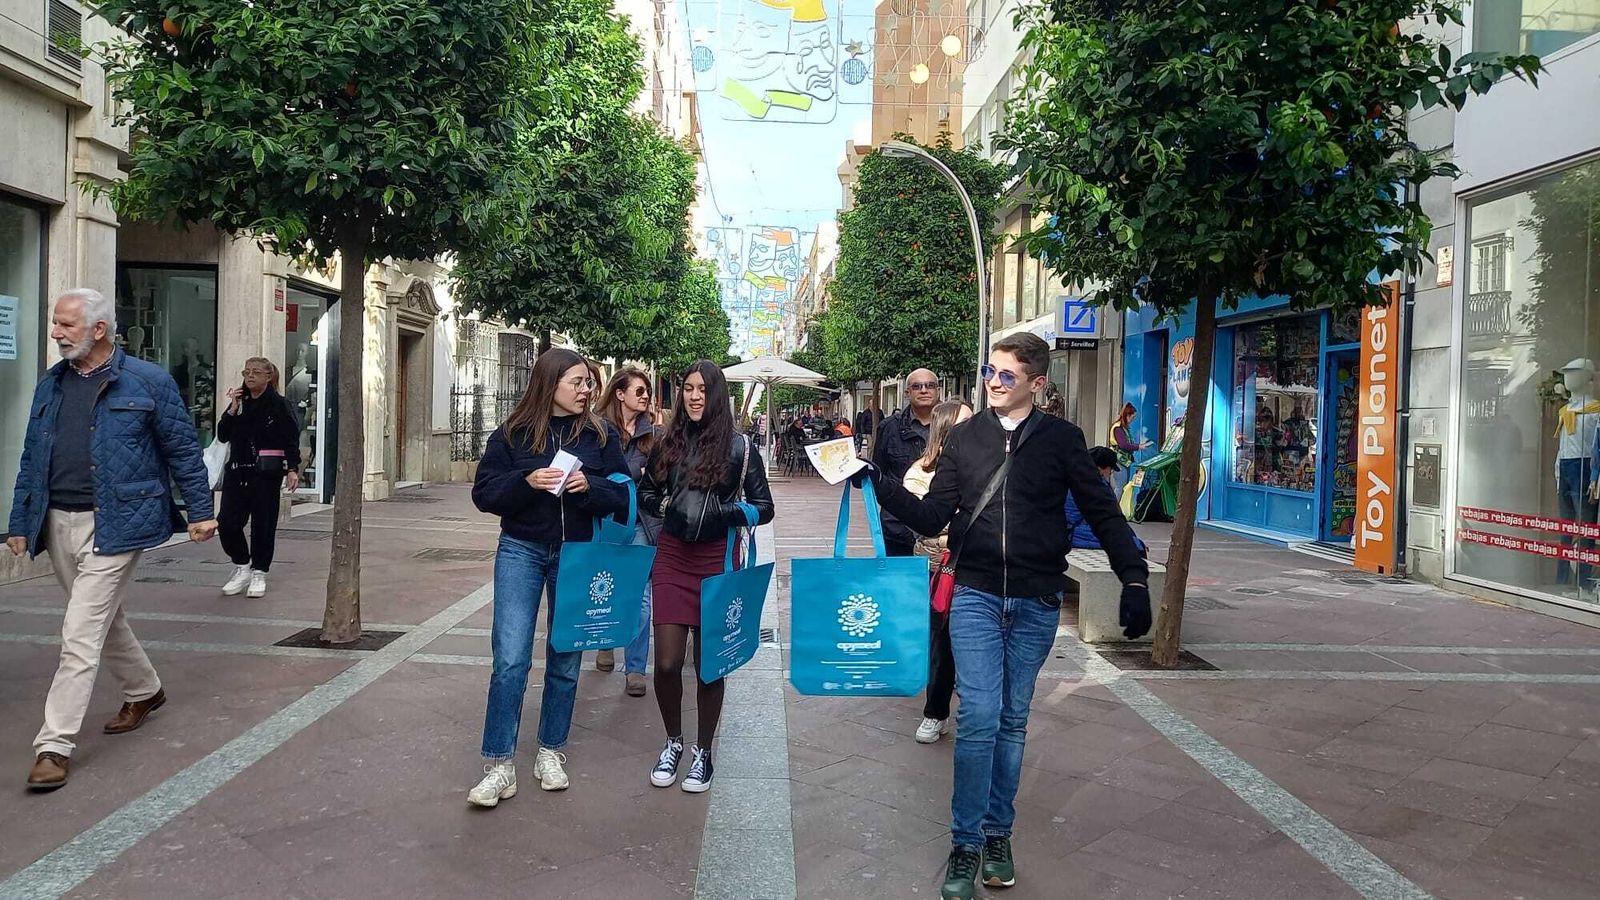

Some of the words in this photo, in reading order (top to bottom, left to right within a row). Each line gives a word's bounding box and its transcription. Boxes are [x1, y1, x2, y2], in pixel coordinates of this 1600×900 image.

[1362, 305, 1388, 455] Planet
[1361, 470, 1391, 548] Toy
[1459, 508, 1489, 520] rebajas
[1491, 512, 1523, 526] rebajas
[1525, 518, 1560, 531] rebajas
[1562, 522, 1600, 537] rebajas
[1458, 529, 1488, 542] rebajas
[1490, 535, 1522, 549] rebajas
[1523, 541, 1558, 555] rebajas
[1562, 548, 1600, 562] rebajas
